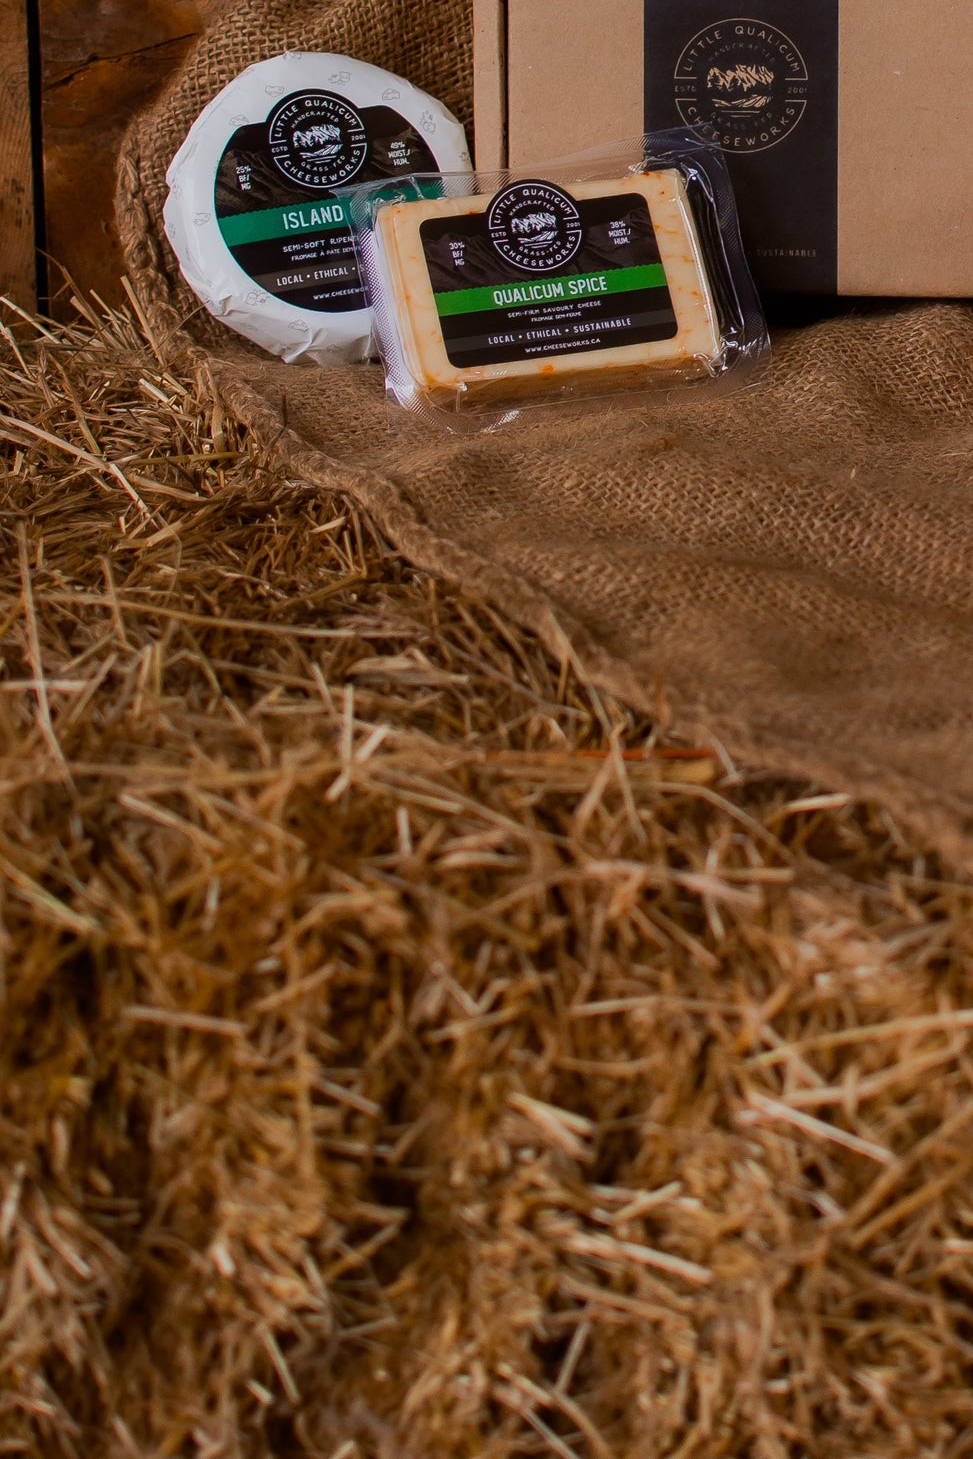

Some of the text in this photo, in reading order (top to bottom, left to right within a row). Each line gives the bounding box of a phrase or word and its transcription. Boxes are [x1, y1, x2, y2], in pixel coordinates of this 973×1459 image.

[683, 26, 800, 72] LITTLE QUALICUM
[274, 100, 357, 137] LITTLE QUALICUM
[291, 111, 339, 128] HANDCRAFTED
[688, 107, 795, 146] CHEESEWORKS
[236, 166, 251, 174] 25%
[284, 150, 360, 184] CHEESEWORKS
[282, 205, 344, 229] ISLAND
[493, 188, 572, 224] LITTLE QUALICUM
[509, 200, 555, 216] HANDCRAFTED
[282, 239, 326, 253] SEMI-SOFT
[449, 242, 465, 250] 30%
[503, 235, 576, 267] CHEESEWORKS
[277, 274, 304, 286] LOCAL
[314, 267, 349, 280] ETHICAL
[493, 276, 608, 306] QUALICUM SPICE
[508, 300, 602, 318] SEMI-FIRM SAVOURY CHEESE
[488, 318, 632, 345] LOCAL ETHICAL SUSTAINABLE
[524, 338, 601, 353] WWW.CHEESEWORKS.CA
